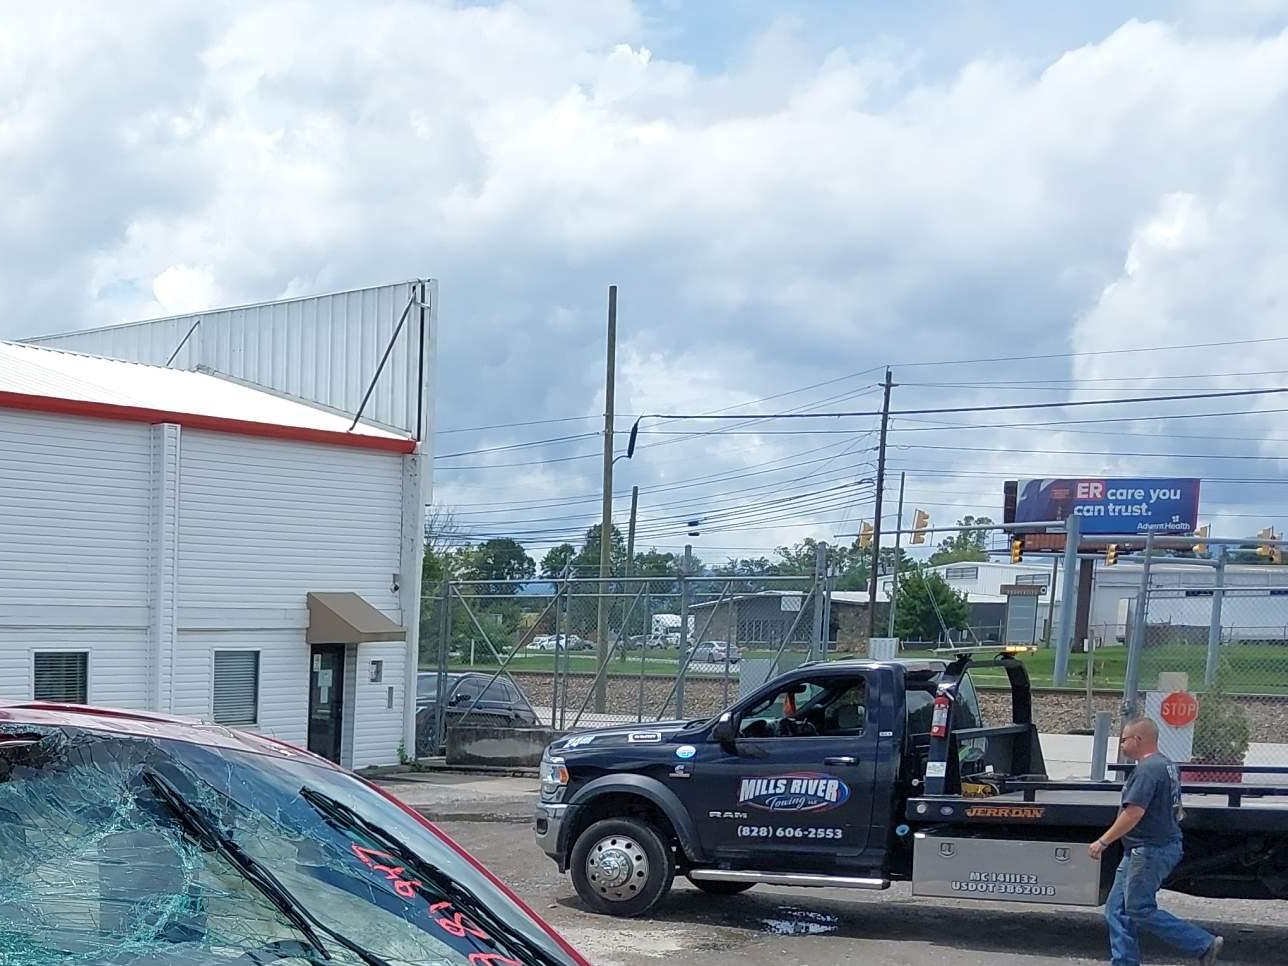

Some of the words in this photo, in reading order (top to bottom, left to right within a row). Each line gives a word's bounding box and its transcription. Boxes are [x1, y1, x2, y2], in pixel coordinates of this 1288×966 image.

[1077, 483, 1102, 499] ER
[1106, 488, 1144, 500] care
[1149, 488, 1181, 503] you
[1073, 504, 1104, 516] can
[1107, 502, 1152, 516] trust.
[1162, 702, 1196, 717] STOP
[739, 779, 787, 802] MILLS
[790, 779, 839, 803] RIVER
[765, 796, 806, 812] Towing
[709, 811, 748, 819] RAM
[737, 825, 773, 838] (828)
[775, 827, 843, 839] 606-2553
[969, 872, 989, 881] MC
[952, 881, 996, 893] USDOT
[999, 883, 1056, 896] 3862018
